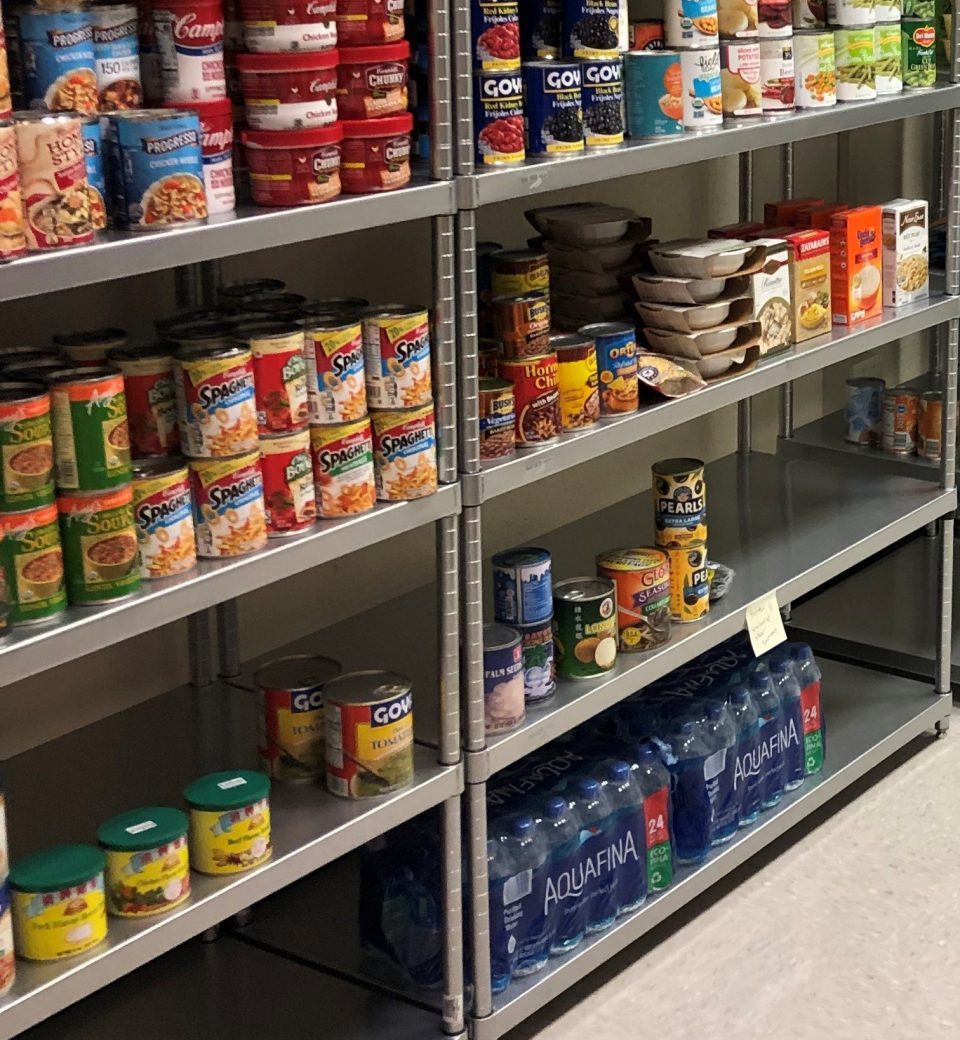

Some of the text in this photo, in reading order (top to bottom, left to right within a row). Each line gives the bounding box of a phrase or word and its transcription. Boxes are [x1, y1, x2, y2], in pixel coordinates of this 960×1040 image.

[101, 62, 121, 75] 150
[369, 72, 404, 87] CHUNKY
[801, 236, 830, 254] ZATARAIN'S
[532, 398, 546, 409] with
[661, 498, 703, 514] PEARLS
[486, 667, 506, 679] PALM
[803, 705, 817, 723] 24
[733, 717, 800, 792] AQUAFINA
[648, 814, 665, 834] 24
[544, 830, 640, 916] AQUAFINA
